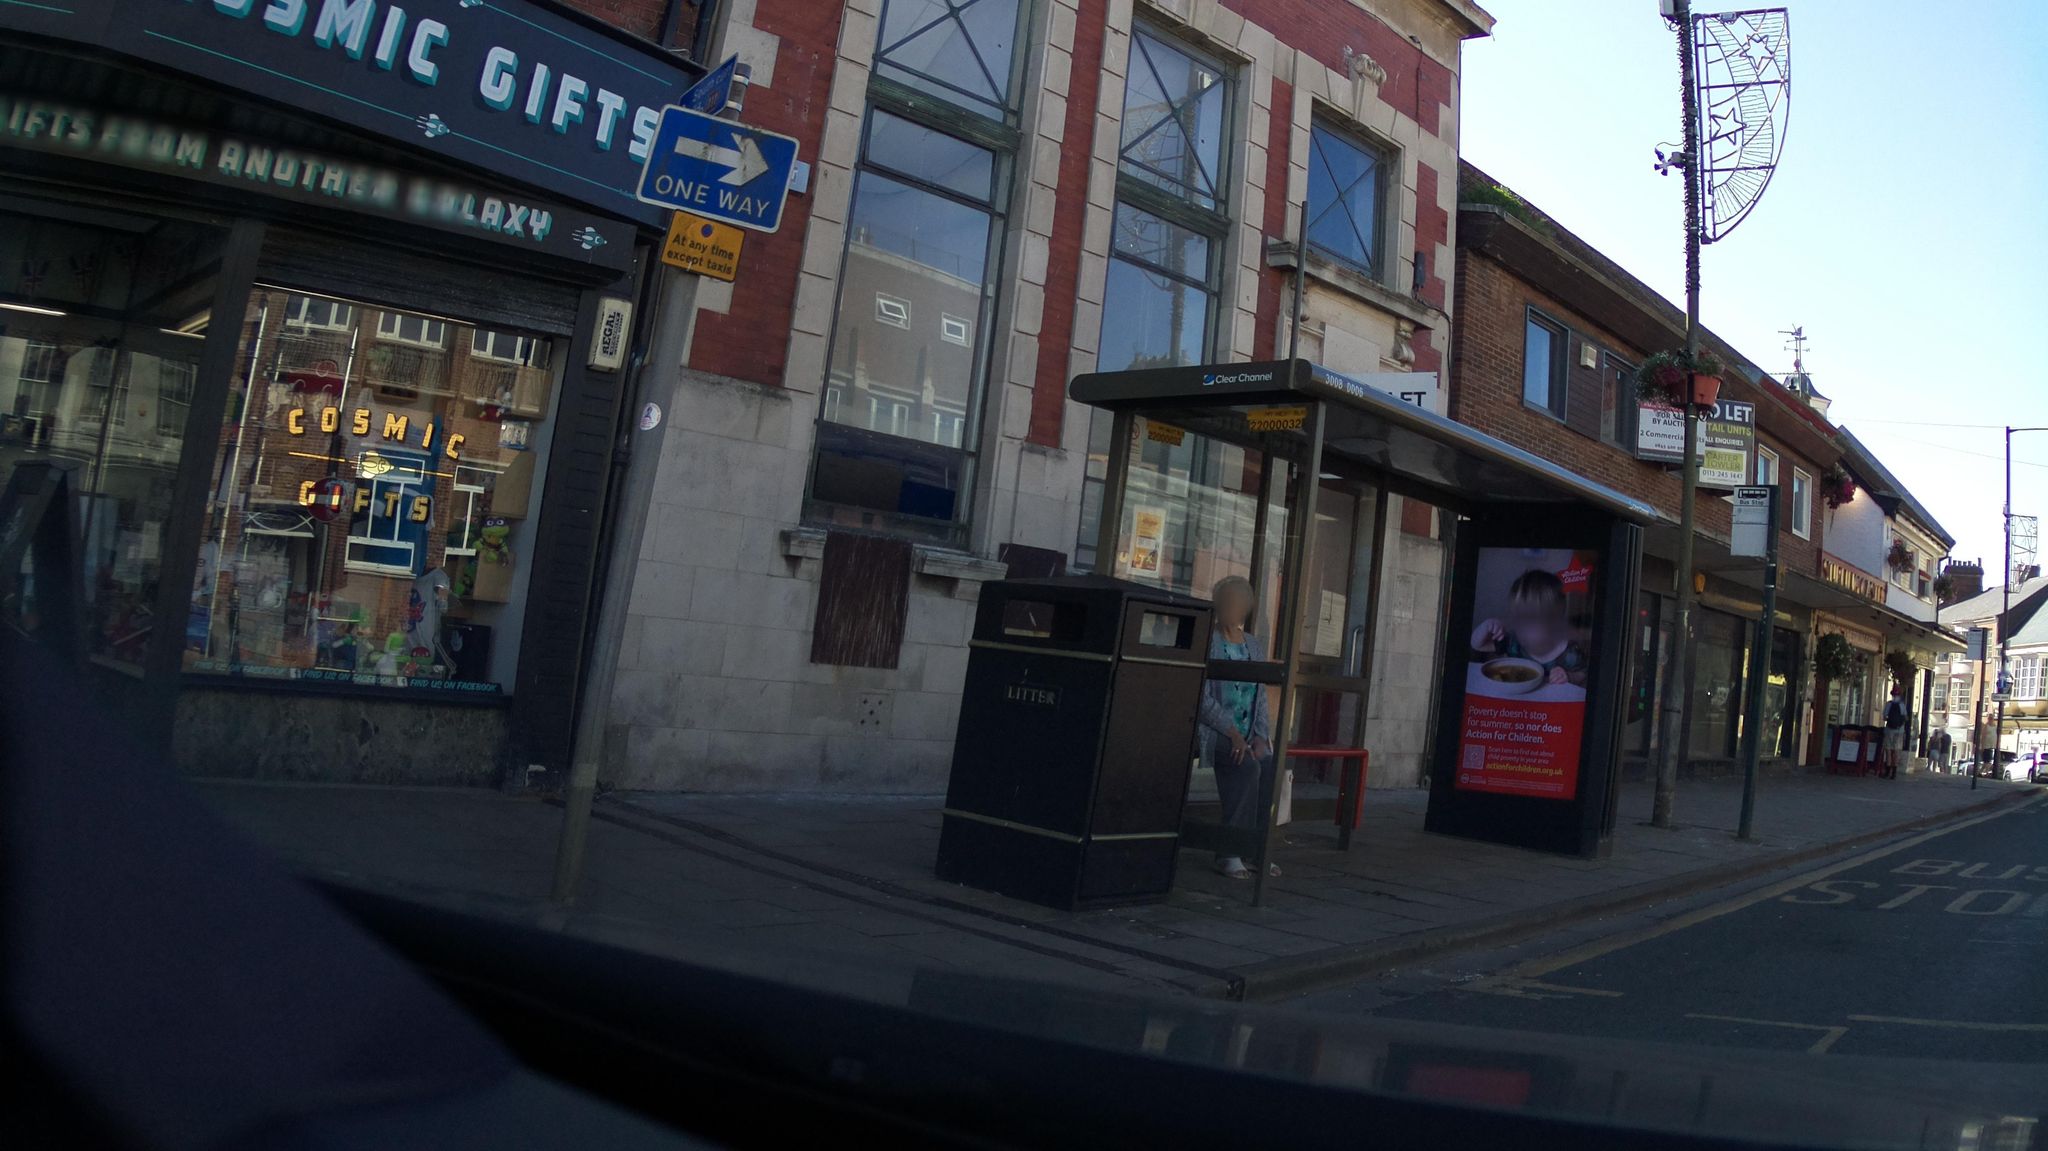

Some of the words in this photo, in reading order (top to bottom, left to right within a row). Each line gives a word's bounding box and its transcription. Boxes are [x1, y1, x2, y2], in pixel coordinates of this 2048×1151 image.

[480, 46, 661, 164] GIFTS
[0, 101, 93, 146] IFTS
[655, 174, 711, 204] ONE
[718, 188, 772, 219] WAY
[672, 232, 688, 246] At
[688, 238, 709, 254] any
[710, 243, 735, 261] time
[666, 248, 705, 267] except
[706, 257, 733, 275] taxis
[602, 311, 617, 356] REGAL
[1215, 374, 1237, 384] Clear
[1238, 371, 1273, 383] Channel
[1389, 391, 1427, 407] ET
[1725, 404, 1753, 423] LET
[288, 405, 466, 460] COSMIC
[1645, 430, 1685, 441] Commercia
[1706, 422, 1726, 433] TAIL
[1727, 424, 1753, 437] UNITS
[1714, 437, 1745, 447] ENQUIRIES
[298, 480, 430, 522] GIFTS
[303, 669, 322, 679] FIND
[324, 671, 337, 680] US
[338, 672, 350, 681] ON
[409, 678, 429, 688] FIND
[430, 679, 443, 689] US
[444, 681, 457, 690] ON
[457, 681, 498, 692] FACEBOOK
[1007, 685, 1055, 705] LITTER
[1469, 704, 1499, 718] Poverty
[1499, 707, 1528, 718] doesn't
[1529, 710, 1548, 722] stop
[1467, 717, 1479, 727] for
[1514, 721, 1525, 730] so
[1526, 722, 1541, 732] nor
[1541, 722, 1563, 733] does
[1465, 728, 1493, 740] Action
[1493, 730, 1507, 741] for
[1507, 732, 1545, 744] Children.
[1485, 762, 1564, 777] actionforchildren.org.uk
